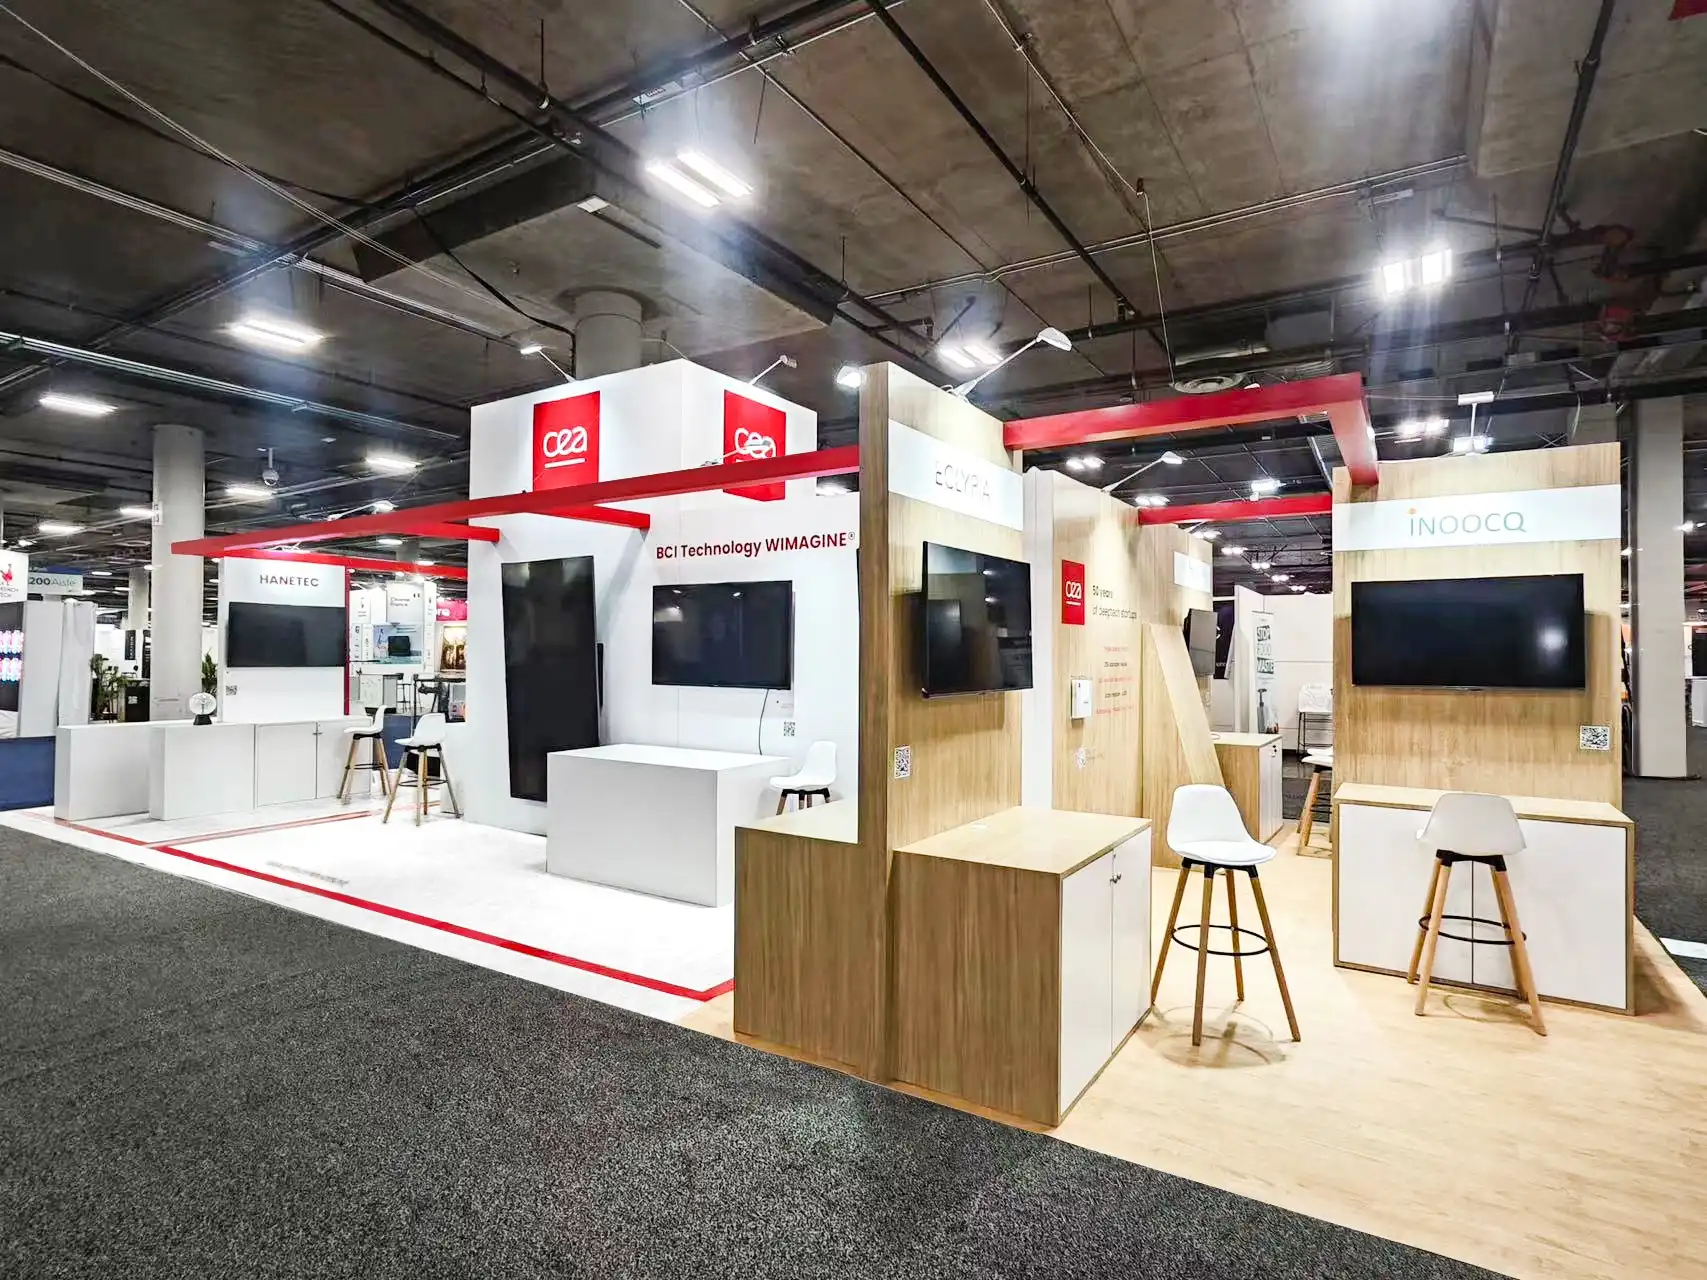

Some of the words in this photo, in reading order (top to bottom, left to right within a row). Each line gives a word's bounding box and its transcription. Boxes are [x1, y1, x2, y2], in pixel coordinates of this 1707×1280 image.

[543, 425, 588, 458] cea
[656, 545, 677, 559] BCI
[681, 540, 762, 557] Technology
[259, 574, 319, 587] HANETEC
[1065, 580, 1082, 599] cea
